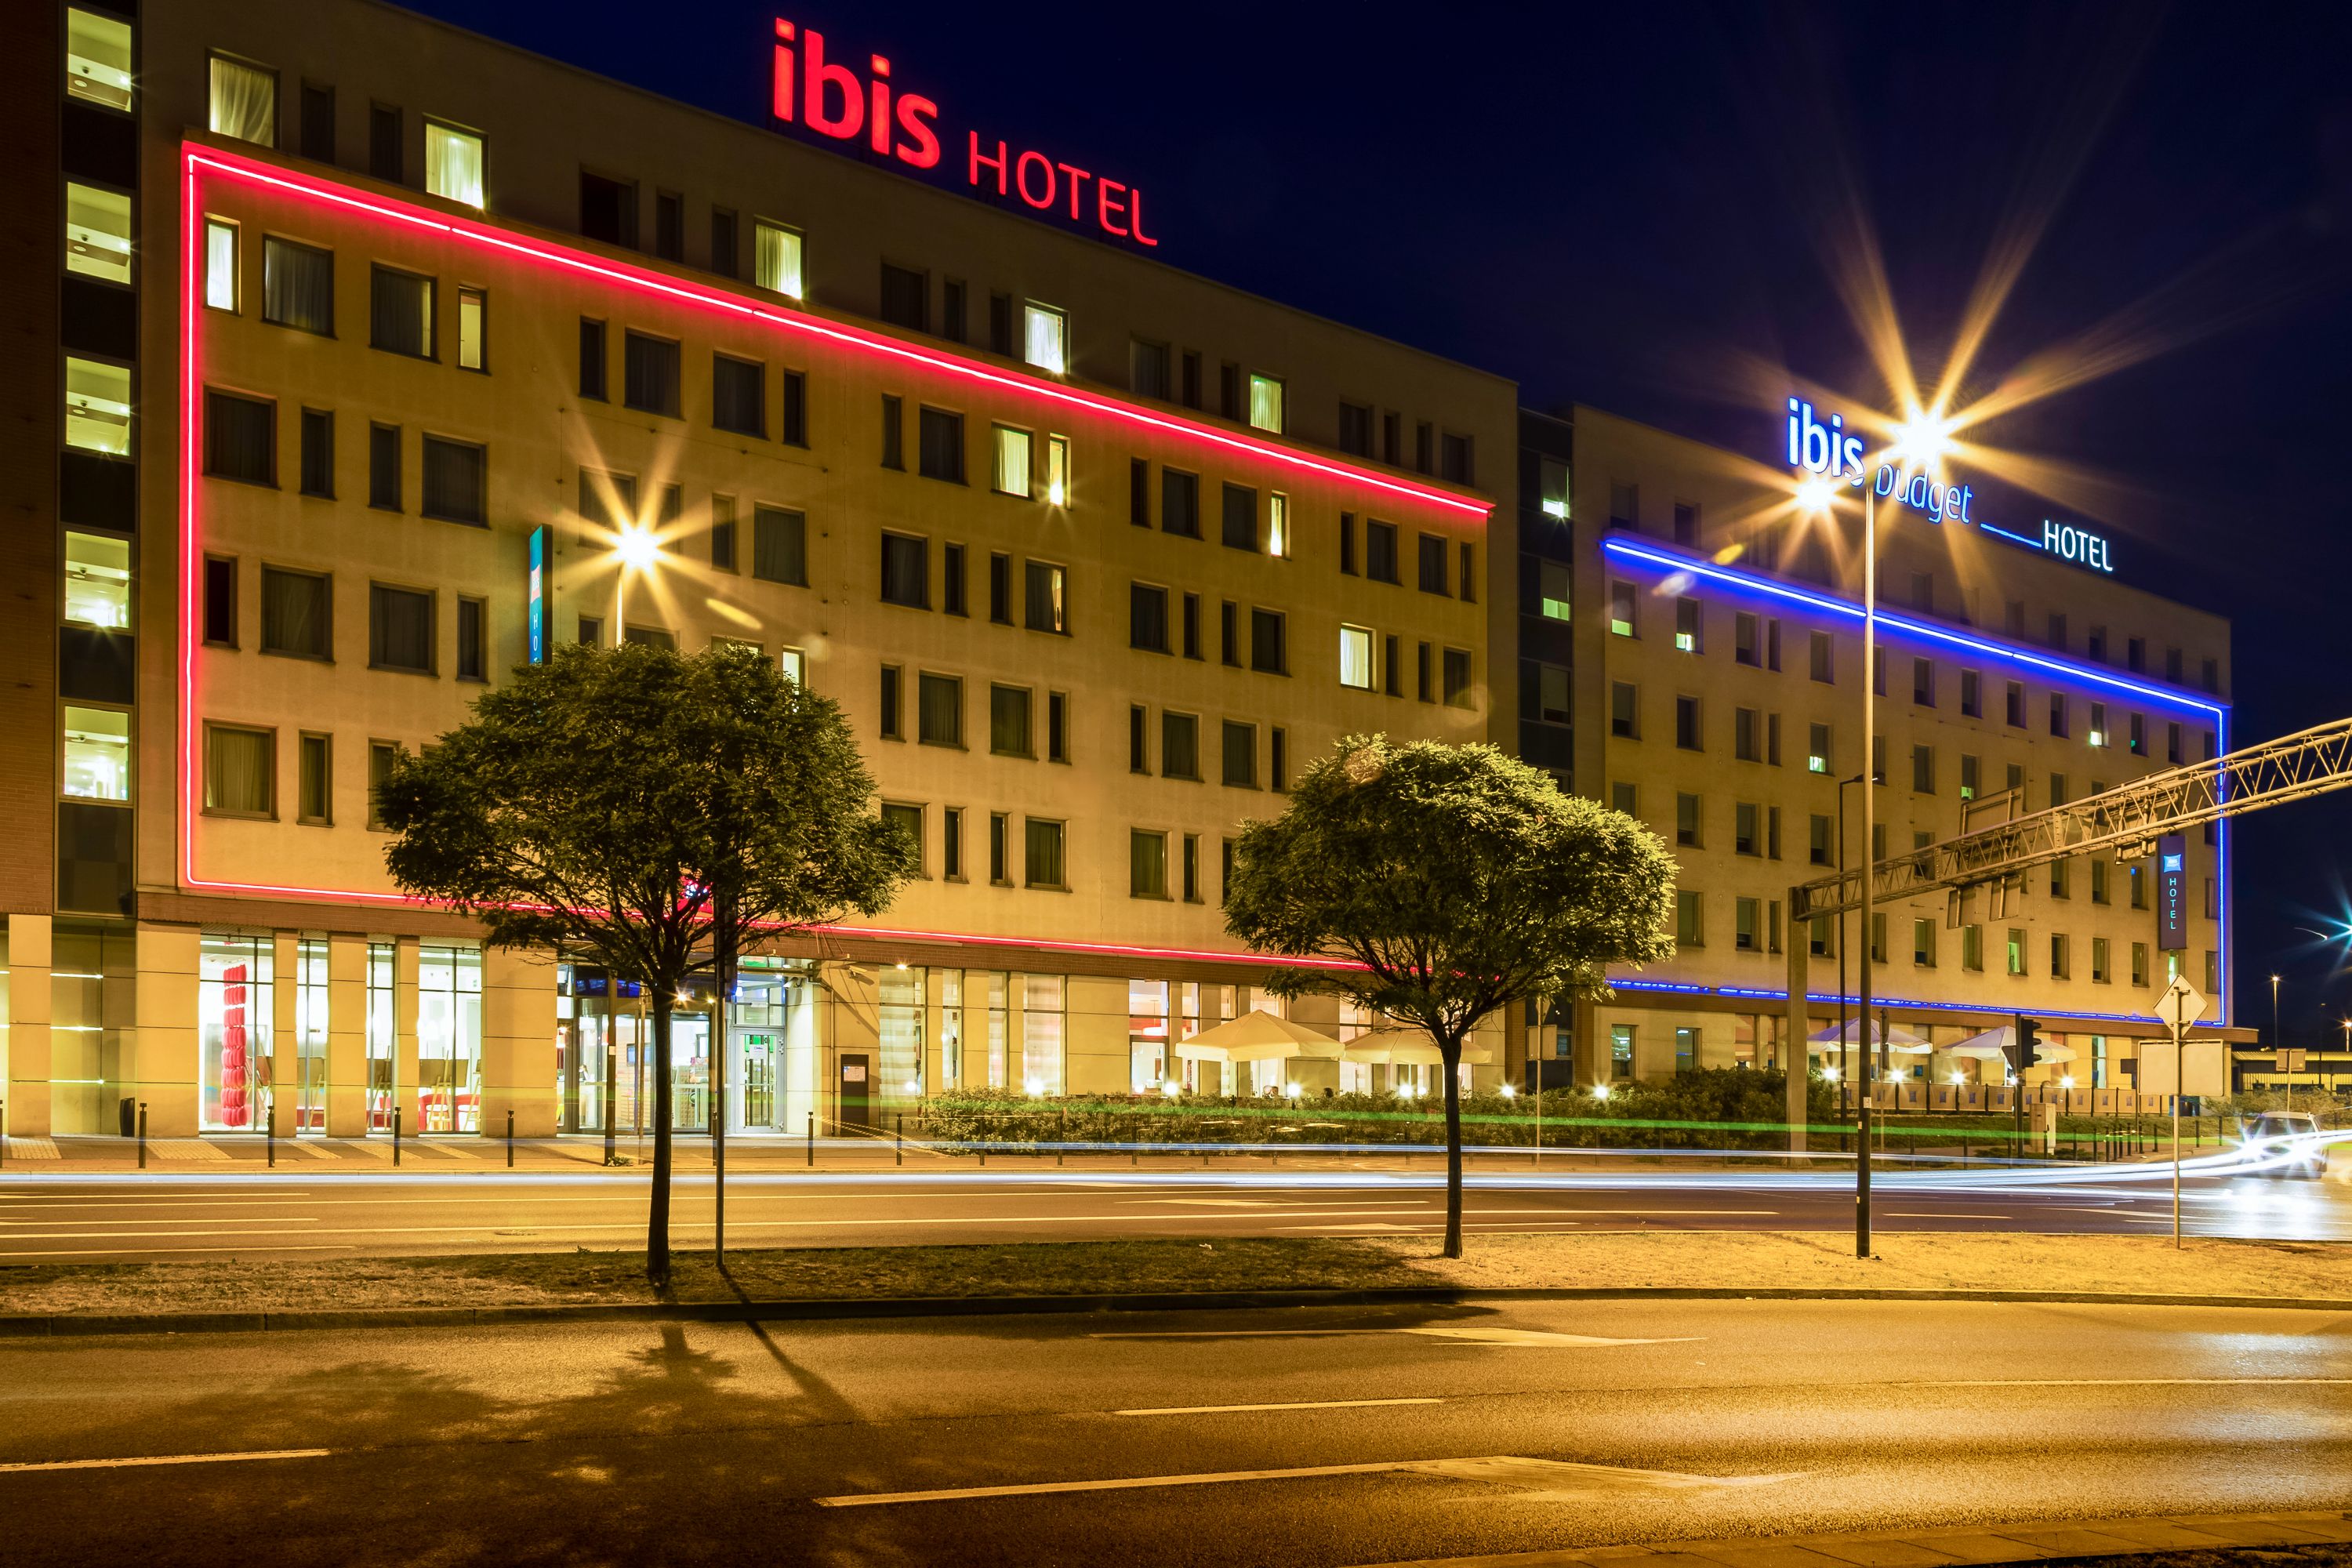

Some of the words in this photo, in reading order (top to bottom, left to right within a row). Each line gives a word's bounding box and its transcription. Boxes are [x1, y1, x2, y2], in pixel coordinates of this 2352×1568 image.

[774, 17, 940, 169] ibis
[969, 129, 1158, 245] HOTEL
[1788, 397, 1865, 488] ibis
[2044, 519, 2114, 572] HOTEL
[2169, 877, 2177, 930] HOTEL
